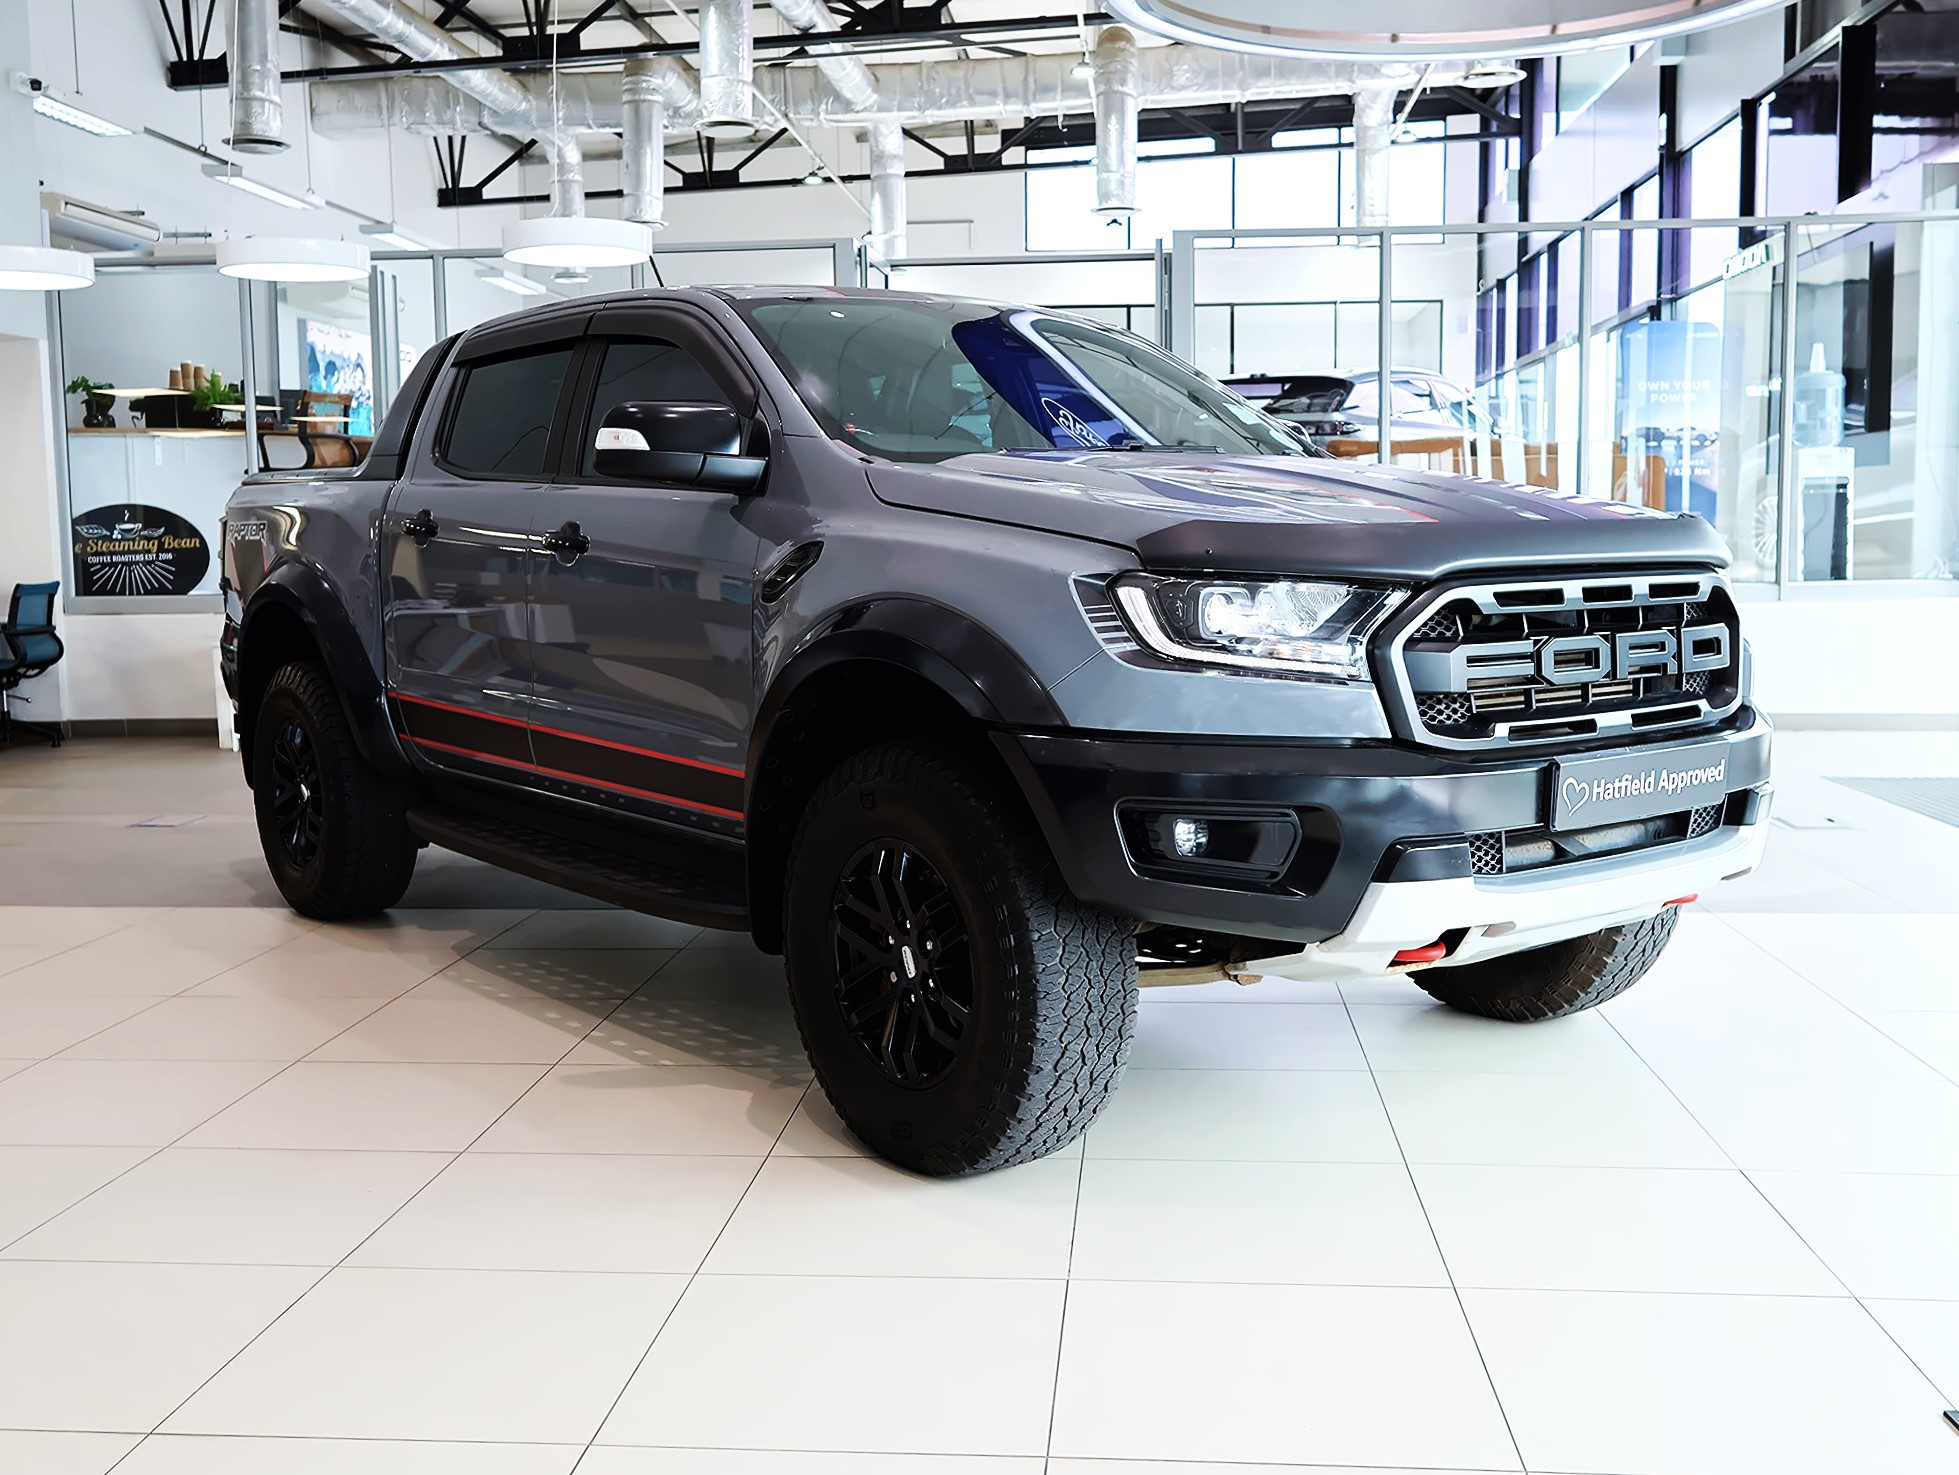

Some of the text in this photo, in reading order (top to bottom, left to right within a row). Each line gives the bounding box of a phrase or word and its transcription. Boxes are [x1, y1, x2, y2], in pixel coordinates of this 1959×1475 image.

[1638, 380, 1711, 392] OWN YOUR
[1650, 392, 1697, 404] POWER
[227, 521, 267, 544] RAPTOR
[86, 538, 158, 553] Steaming
[162, 535, 201, 549] Bean
[87, 556, 111, 564] COFFEE
[112, 554, 144, 562] ROASTERS
[1450, 622, 1730, 693] FORD
[1592, 758, 1726, 802] Hatfield Approved
